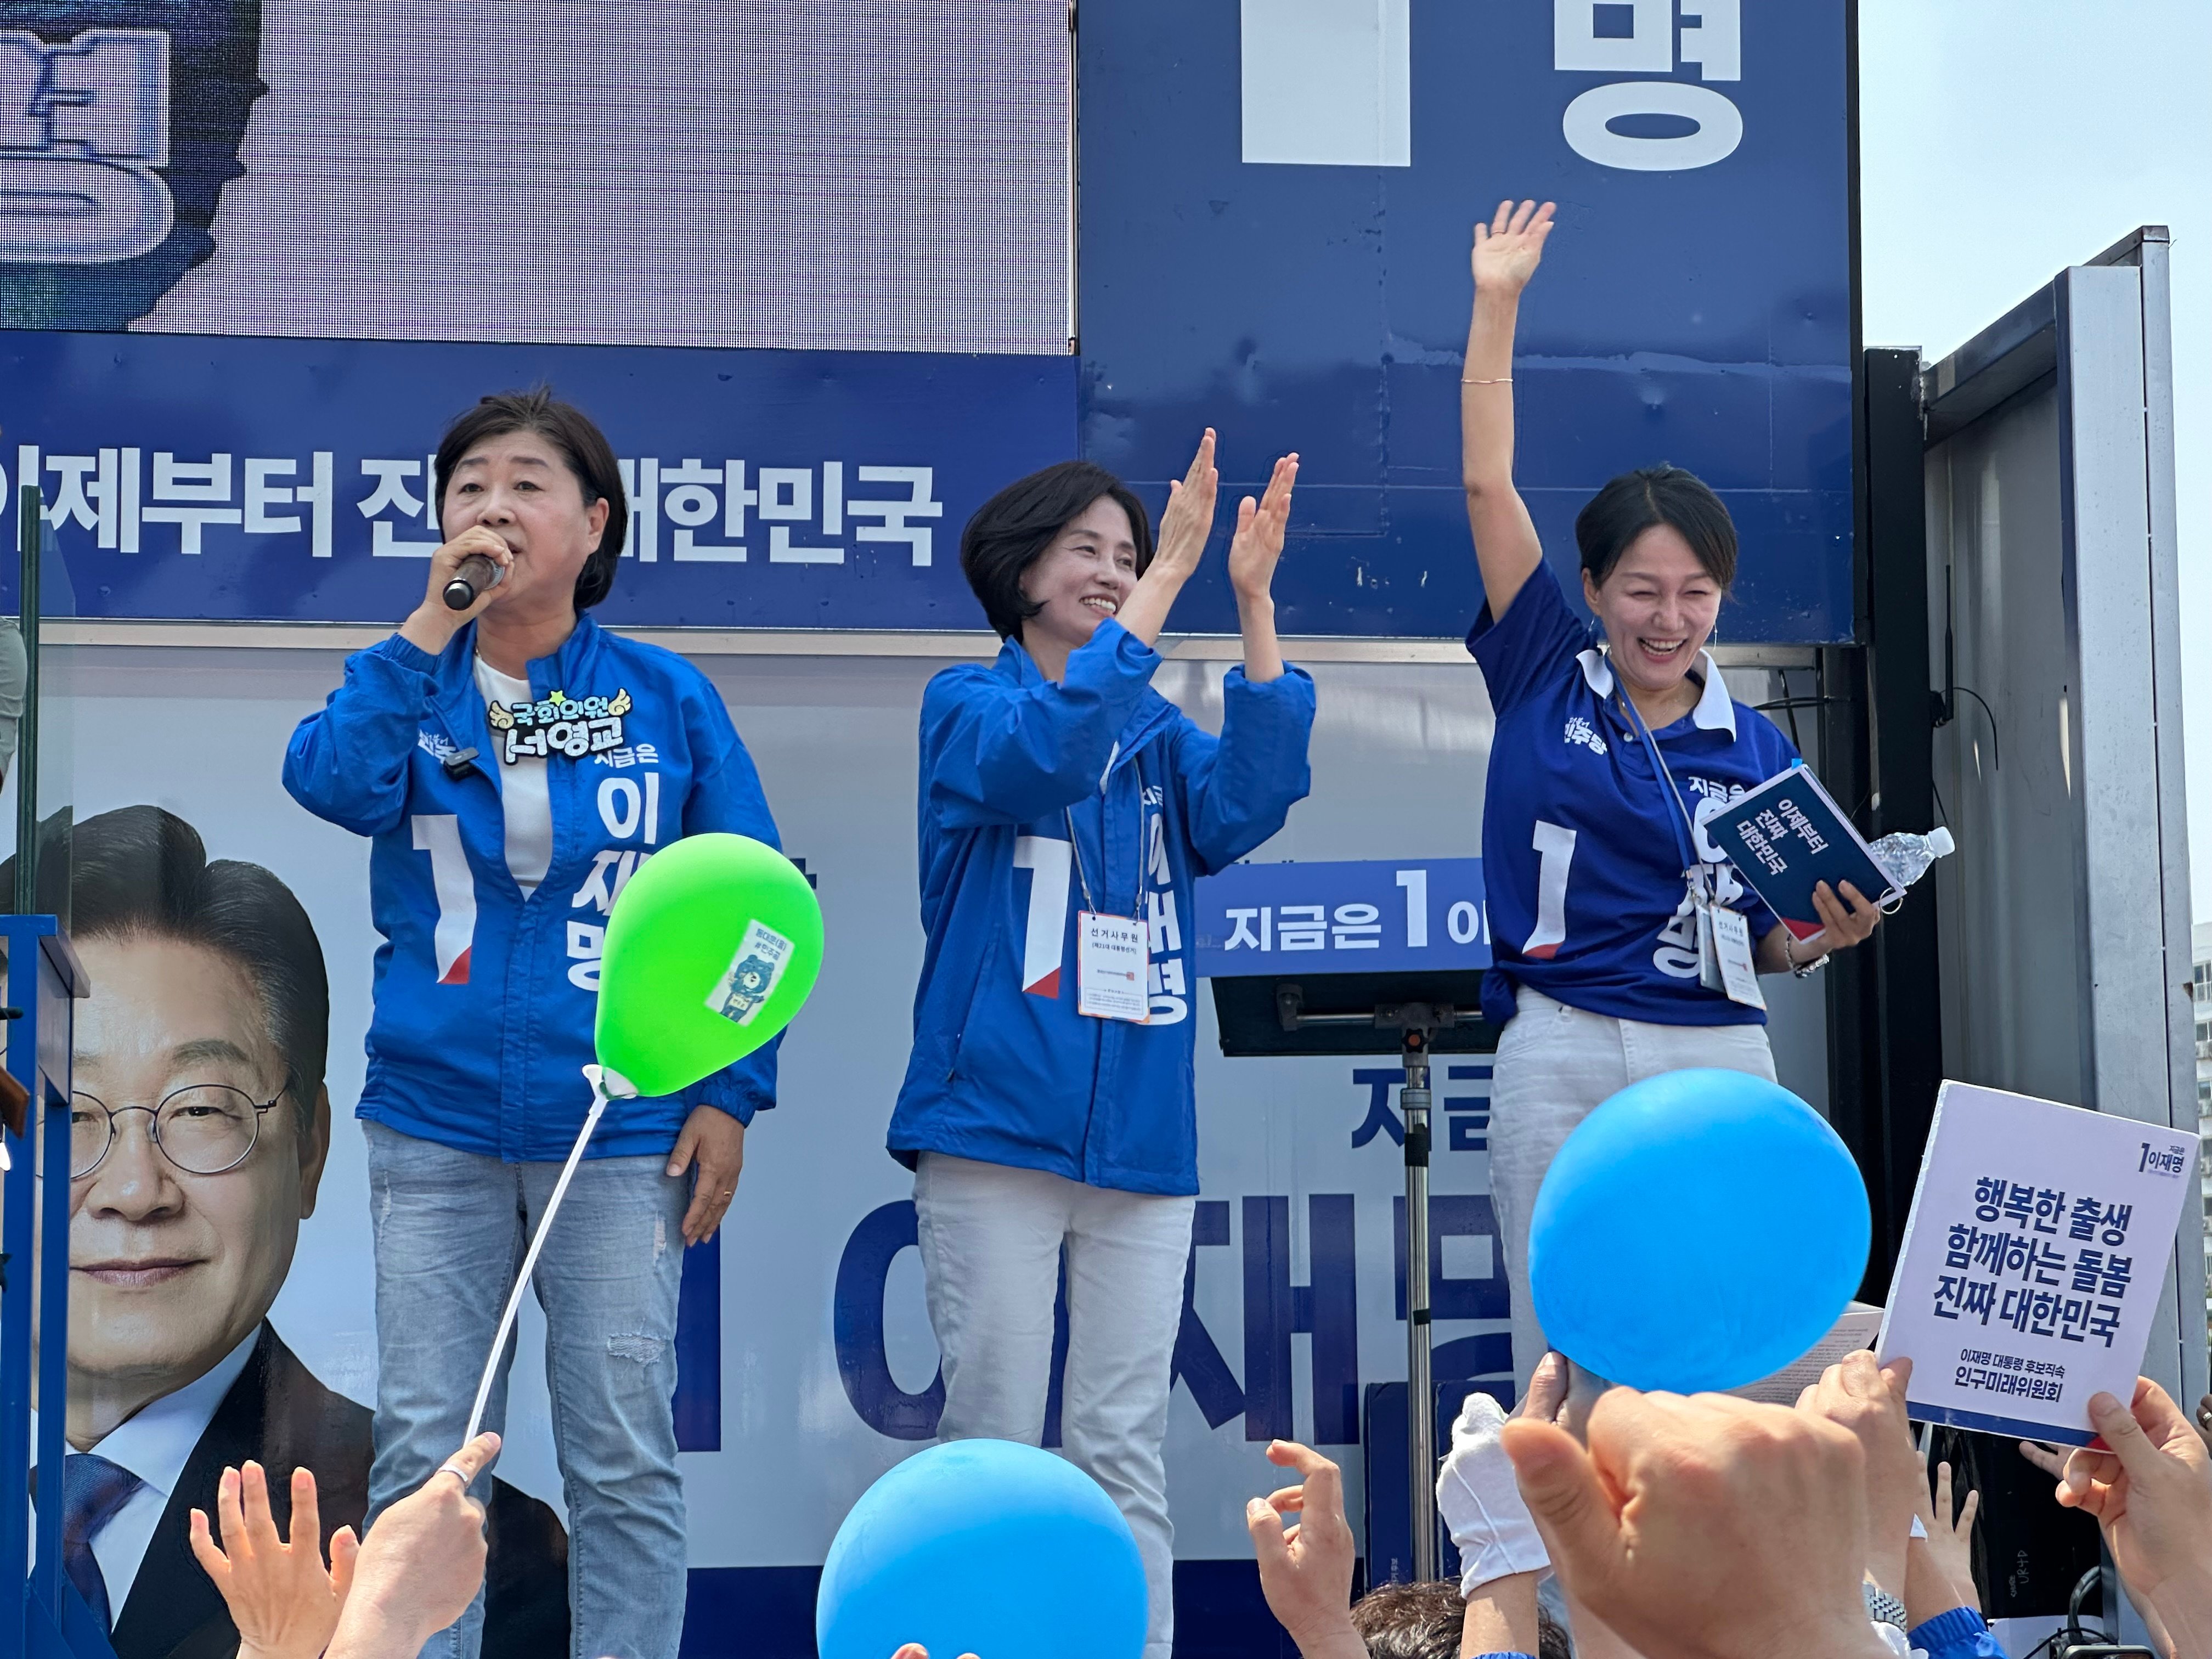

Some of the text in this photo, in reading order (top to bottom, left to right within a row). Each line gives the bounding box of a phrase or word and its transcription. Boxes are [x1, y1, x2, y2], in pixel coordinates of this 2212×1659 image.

[356, 453, 443, 557] 진
[512, 696, 610, 726] 국회의원
[417, 729, 456, 764] 민주
[1736, 820, 1788, 876] 대한민국
[1755, 809, 1788, 841] 진짜
[1778, 799, 1829, 854] 이제부터
[411, 814, 477, 985] 1
[1013, 835, 1073, 999] 1
[1224, 904, 1381, 951] 지금은
[1396, 870, 1427, 947] 1
[1522, 820, 1577, 960] 1
[2138, 1142, 2184, 1173] 1 이재명
[1974, 1176, 2133, 1246] 행복한 출생
[1945, 1223, 2132, 1299] 함께하는 돌봄
[1933, 1274, 2121, 1348] 진짜 대한민국
[1955, 1366, 2063, 1402] 인구미래위원회
[1960, 1348, 2066, 1379] 이재명 대통령 후보직속
